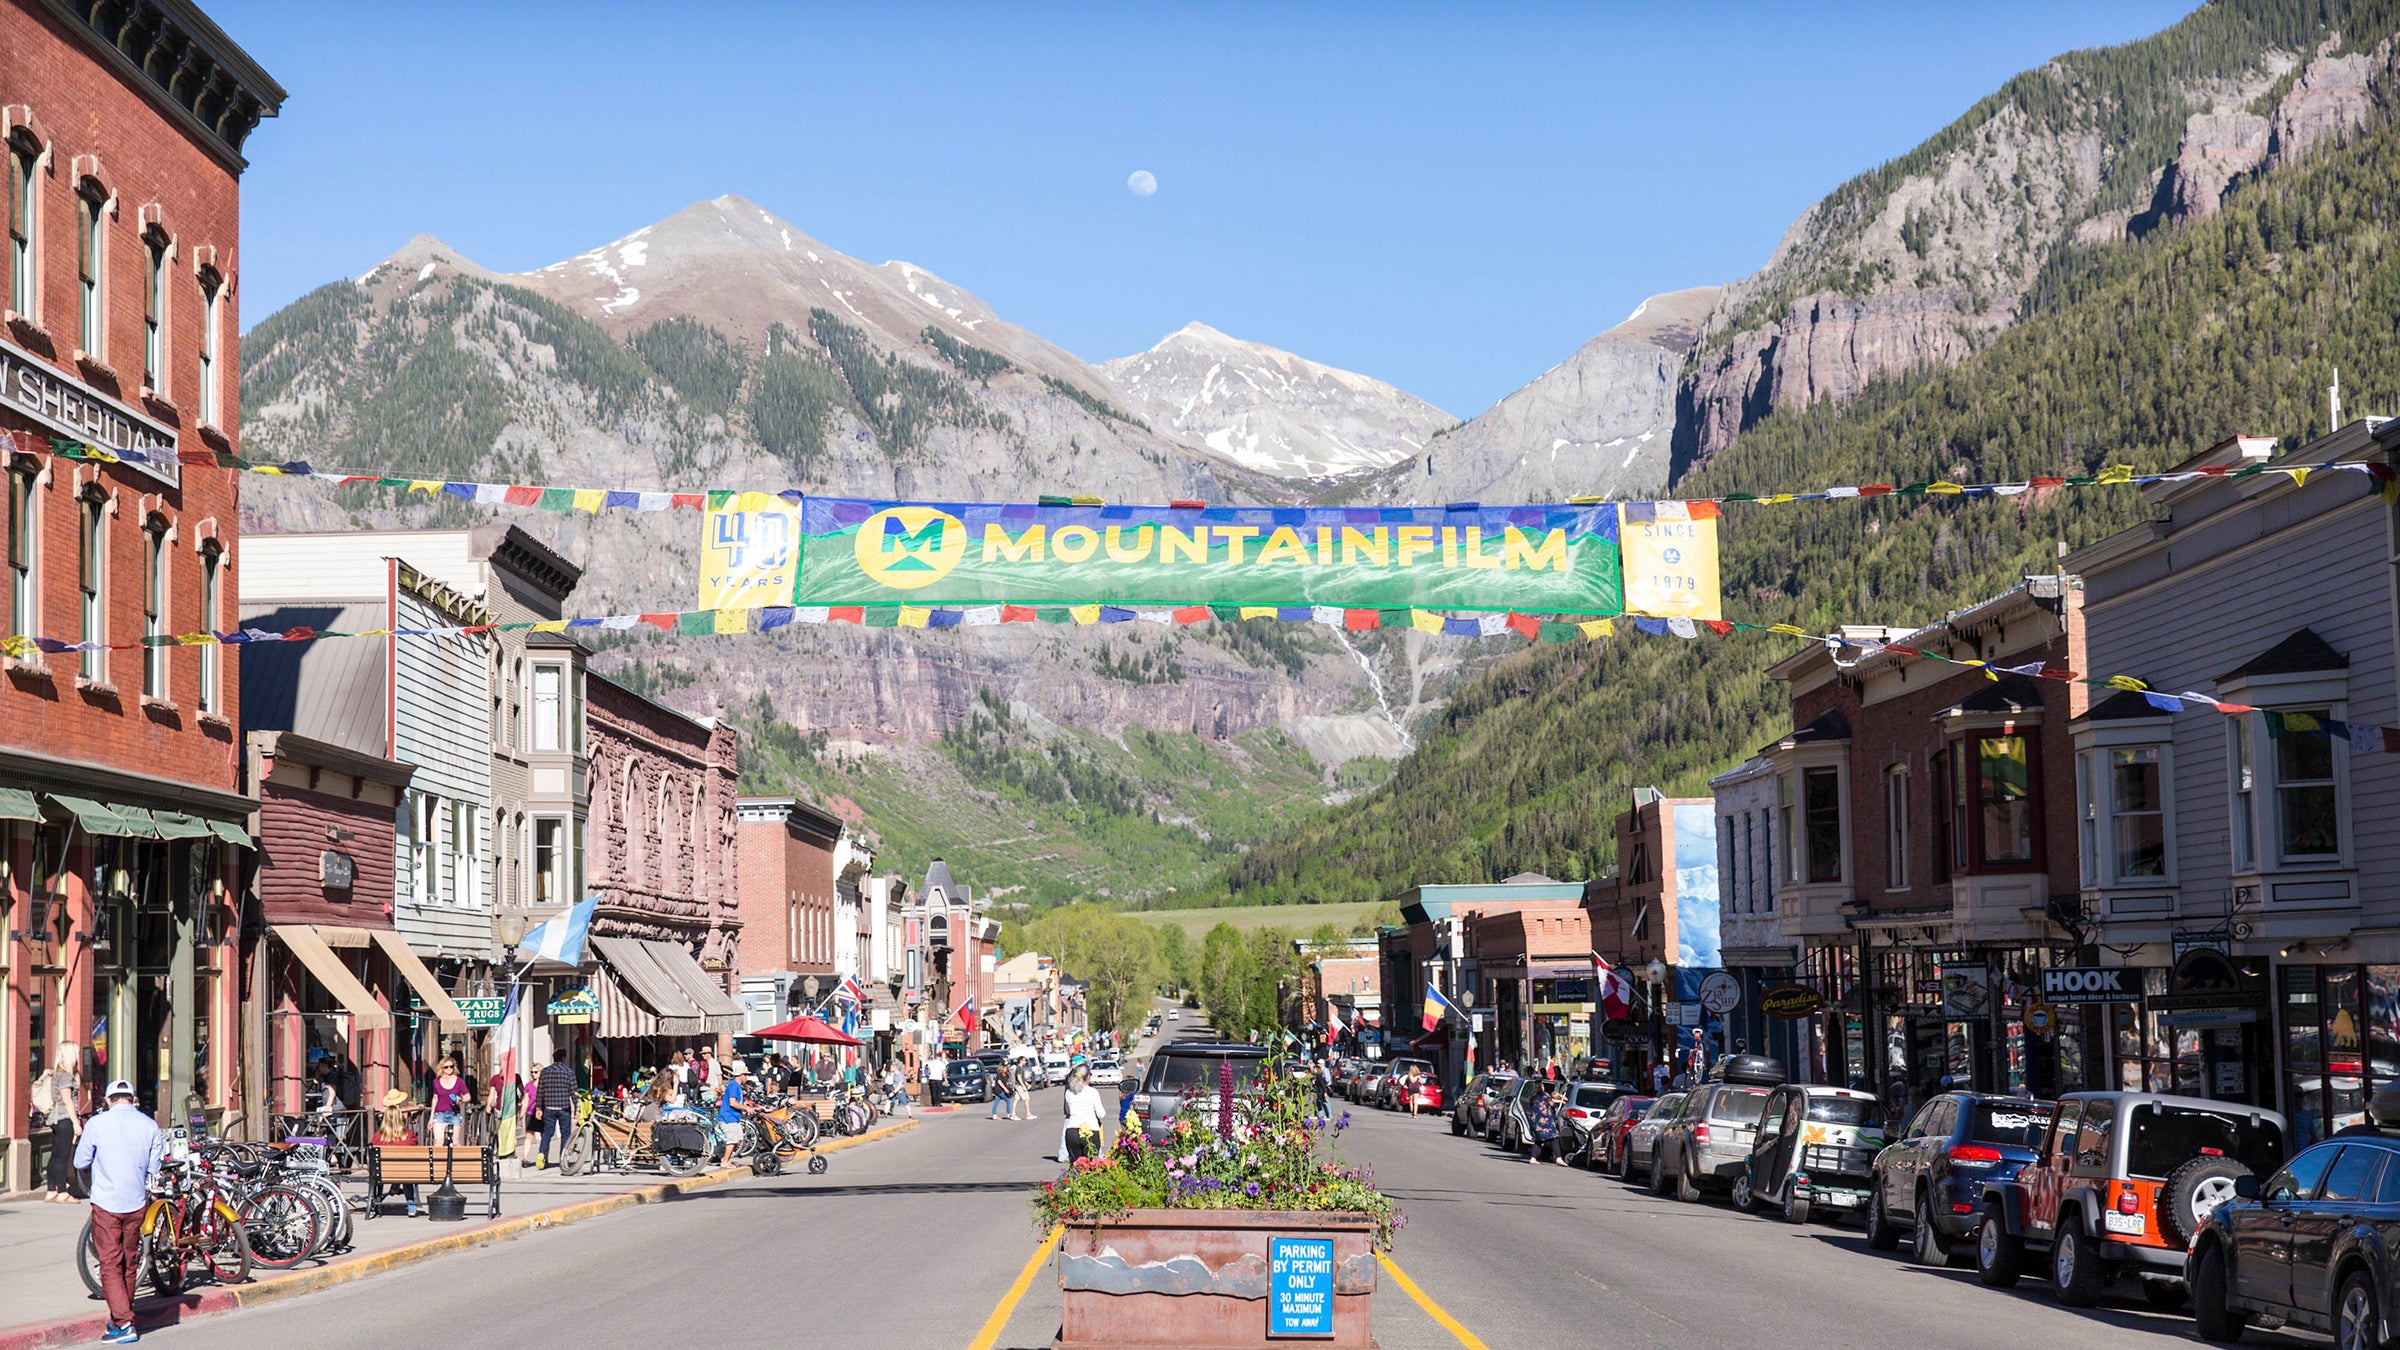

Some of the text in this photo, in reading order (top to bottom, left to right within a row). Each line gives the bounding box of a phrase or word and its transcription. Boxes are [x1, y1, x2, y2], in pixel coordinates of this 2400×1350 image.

[1644, 524, 1695, 537] SINCE
[711, 512, 788, 571] 40
[982, 523, 1567, 571] MOUNTAINFILM
[710, 575, 783, 588] YEARS
[1653, 575, 1695, 590] 1979
[2045, 971, 2121, 991] HOOK
[1702, 987, 1723, 1003] Zia
[1761, 992, 1819, 1011] Paradise
[1712, 996, 1734, 1011] Sun
[473, 1010, 500, 1019] RUGS
[1279, 1245, 1325, 1258] PARKING
[1273, 1260, 1331, 1273] BY PERMIT
[1288, 1275, 1315, 1288] ONLY
[1280, 1293, 1325, 1303] 30 MINUTE
[1282, 1304, 1322, 1313] MAXIMUM
[1285, 1317, 1319, 1327] TOW AWAY
